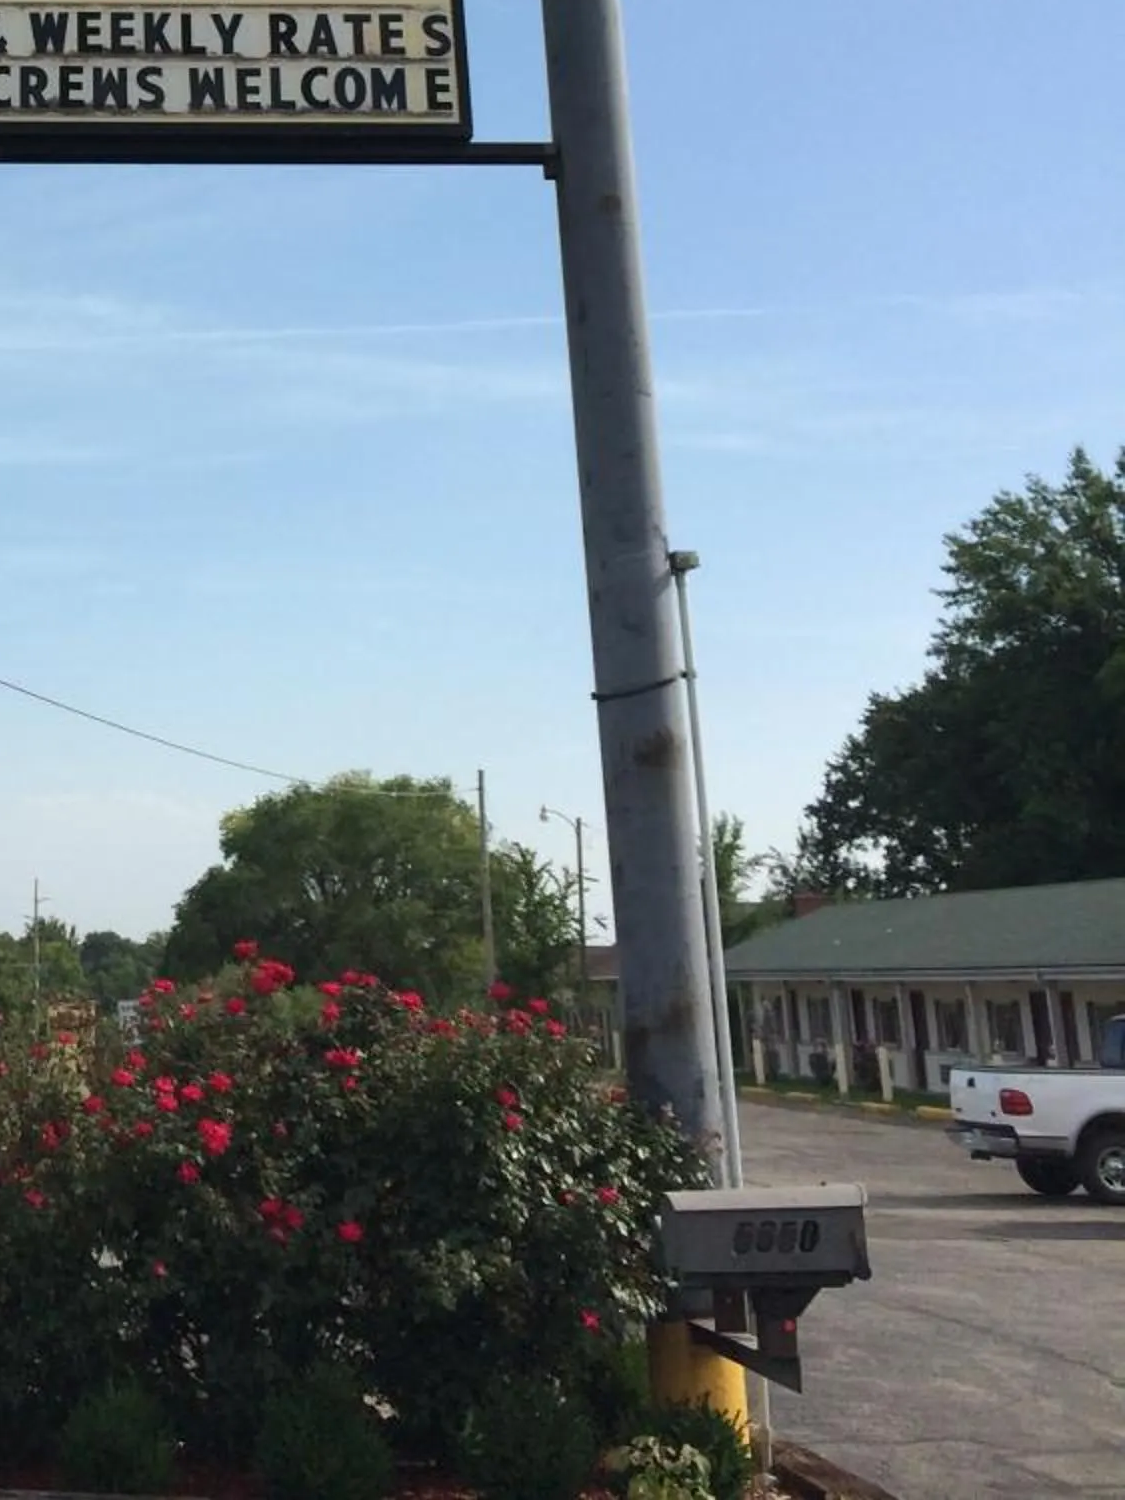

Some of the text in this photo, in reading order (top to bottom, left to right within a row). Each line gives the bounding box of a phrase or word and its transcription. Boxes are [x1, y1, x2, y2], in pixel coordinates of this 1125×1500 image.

[30, 12, 244, 55] WEEKLY
[268, 13, 451, 57] RATES
[189, 66, 453, 112] WELCOME
